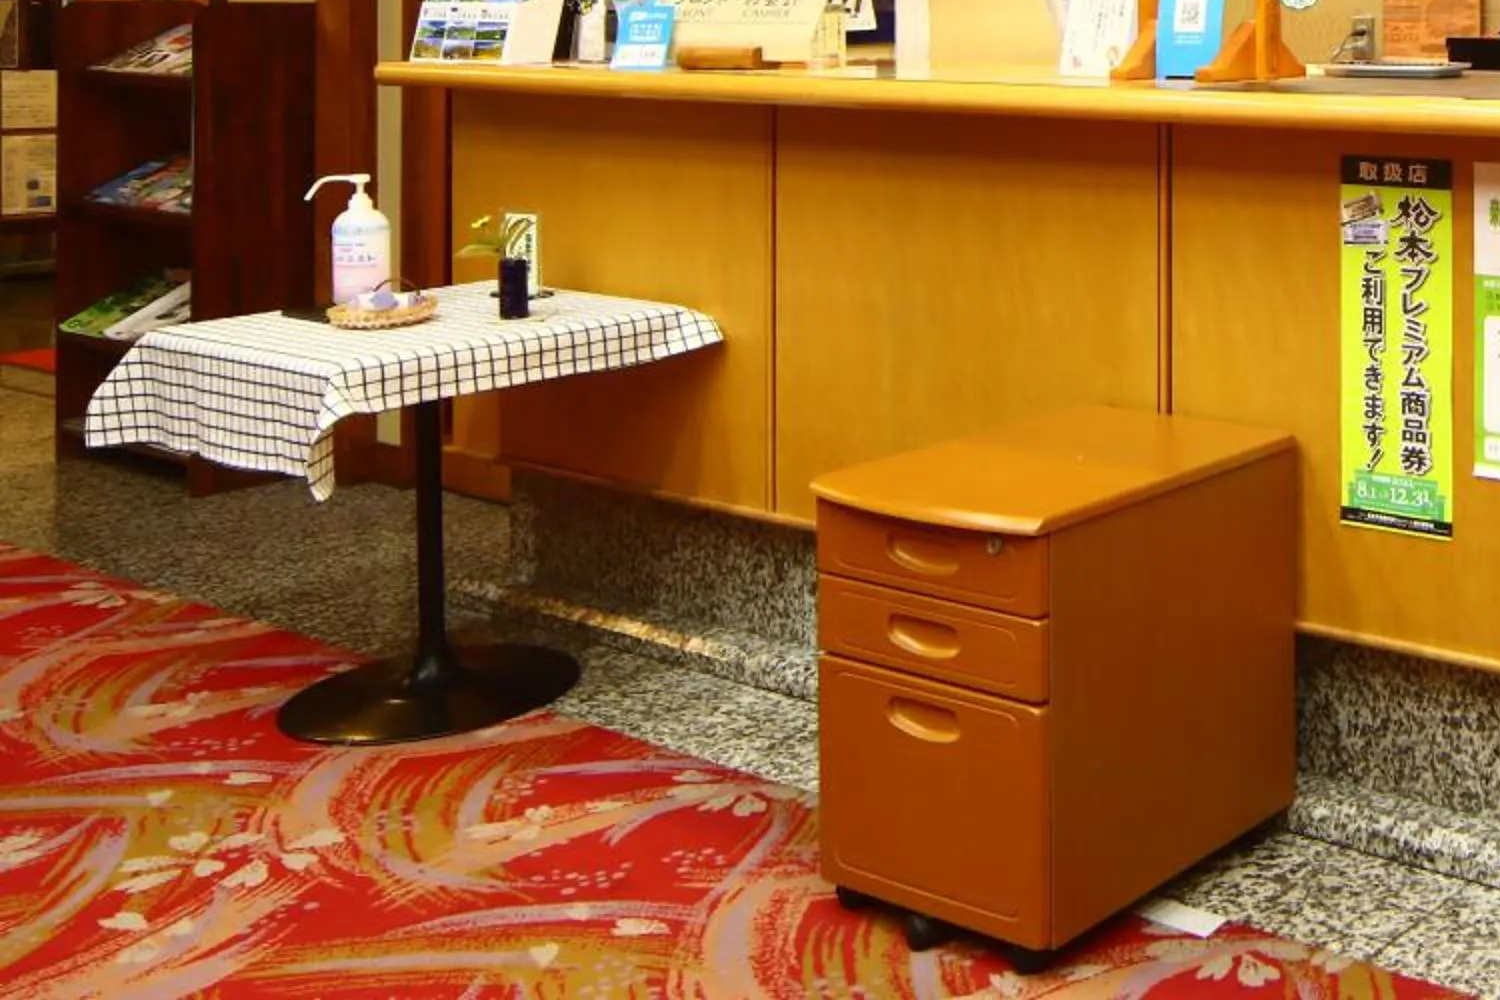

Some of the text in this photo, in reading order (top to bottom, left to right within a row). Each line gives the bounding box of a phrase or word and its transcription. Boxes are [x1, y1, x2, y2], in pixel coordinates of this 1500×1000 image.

[1359, 161, 1428, 183] 取扱店
[1390, 194, 1441, 472] 松本プレミアム商品券
